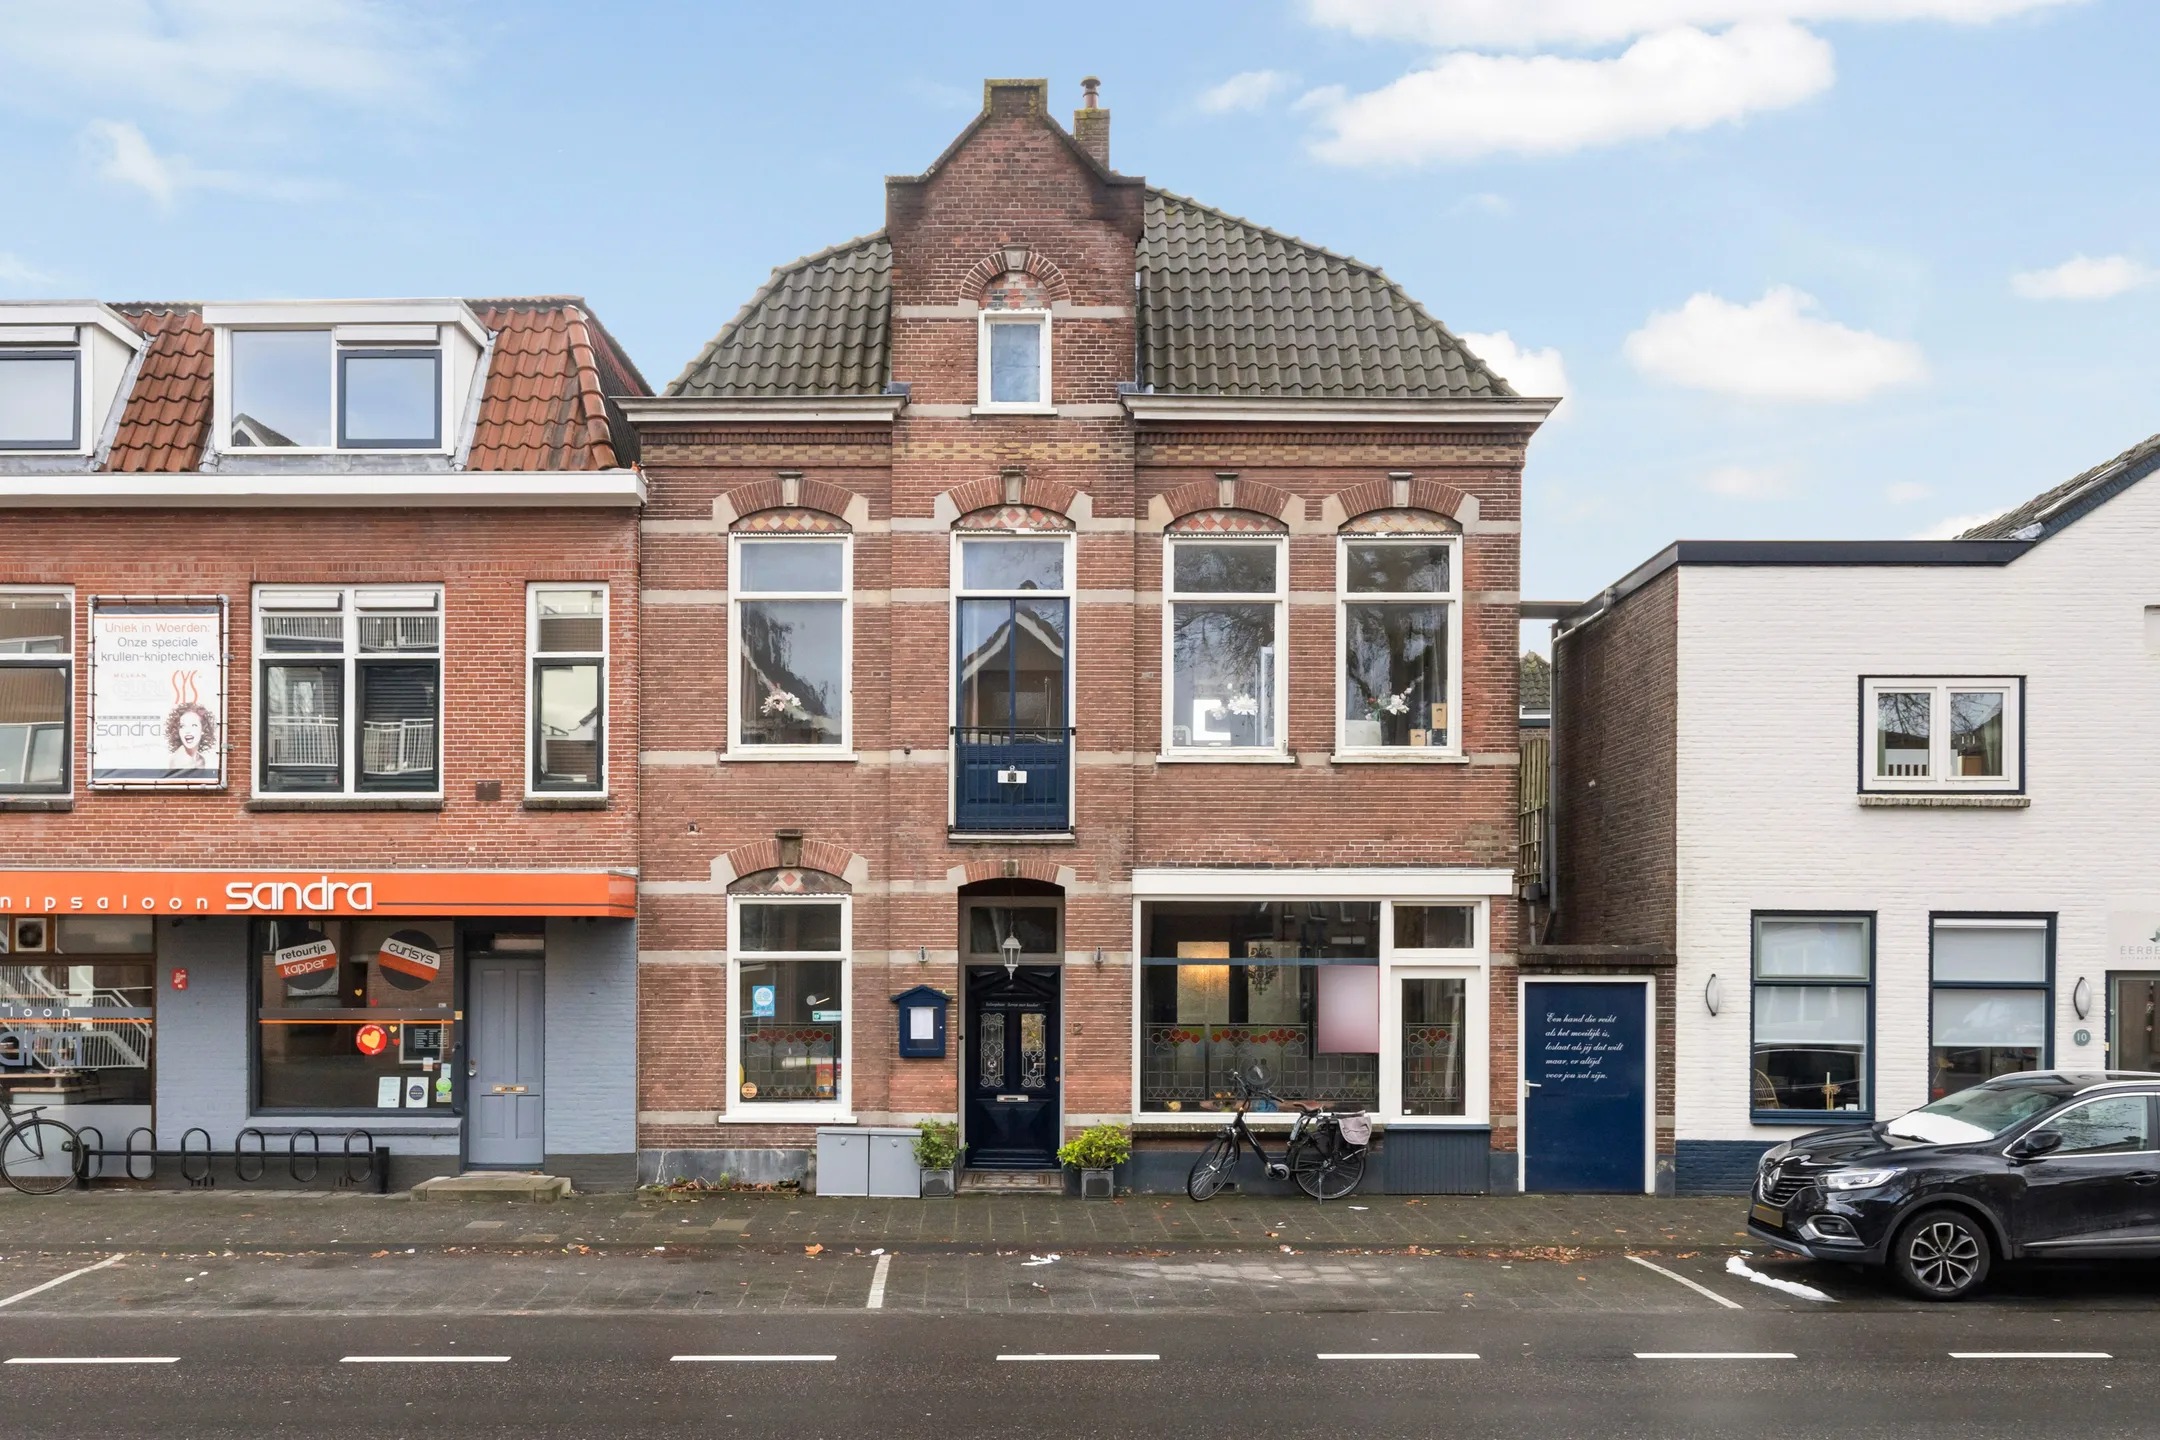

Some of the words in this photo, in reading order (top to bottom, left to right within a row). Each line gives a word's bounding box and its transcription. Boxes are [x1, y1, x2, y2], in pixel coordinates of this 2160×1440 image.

[105, 622, 138, 633] Uniek
[141, 622, 151, 633] in
[155, 622, 210, 633] Woerden:
[117, 636, 148, 647] Onze
[152, 636, 198, 649] speciale
[101, 651, 215, 663] krullen-kniptechniek
[96, 721, 161, 737] sandra
[225, 875, 373, 911] sandra
[281, 943, 327, 961] retourtje
[284, 957, 328, 976] kapper
[1546, 1012, 1562, 1023] Een
[1563, 1014, 1585, 1023] hand
[1584, 1014, 1597, 1023] die
[1597, 1014, 1617, 1023] reikt
[1545, 1028, 1556, 1037] als
[1557, 1028, 1570, 1037] het
[1570, 1028, 1601, 1040] moeilijk
[1601, 1029, 1610, 1038] is,
[2077, 1033, 2087, 1042] 10
[1545, 1042, 1571, 1051] loslaat
[1571, 1042, 1582, 1051] als
[1580, 1043, 1593, 1054] jij
[1593, 1042, 1608, 1051] dat
[1607, 1042, 1624, 1051] wilt
[1580, 1056, 1603, 1068] altijd
[1560, 1071, 1576, 1082] jou
[1577, 1070, 1591, 1079] zal
[1591, 1071, 1608, 1082] zijn.
